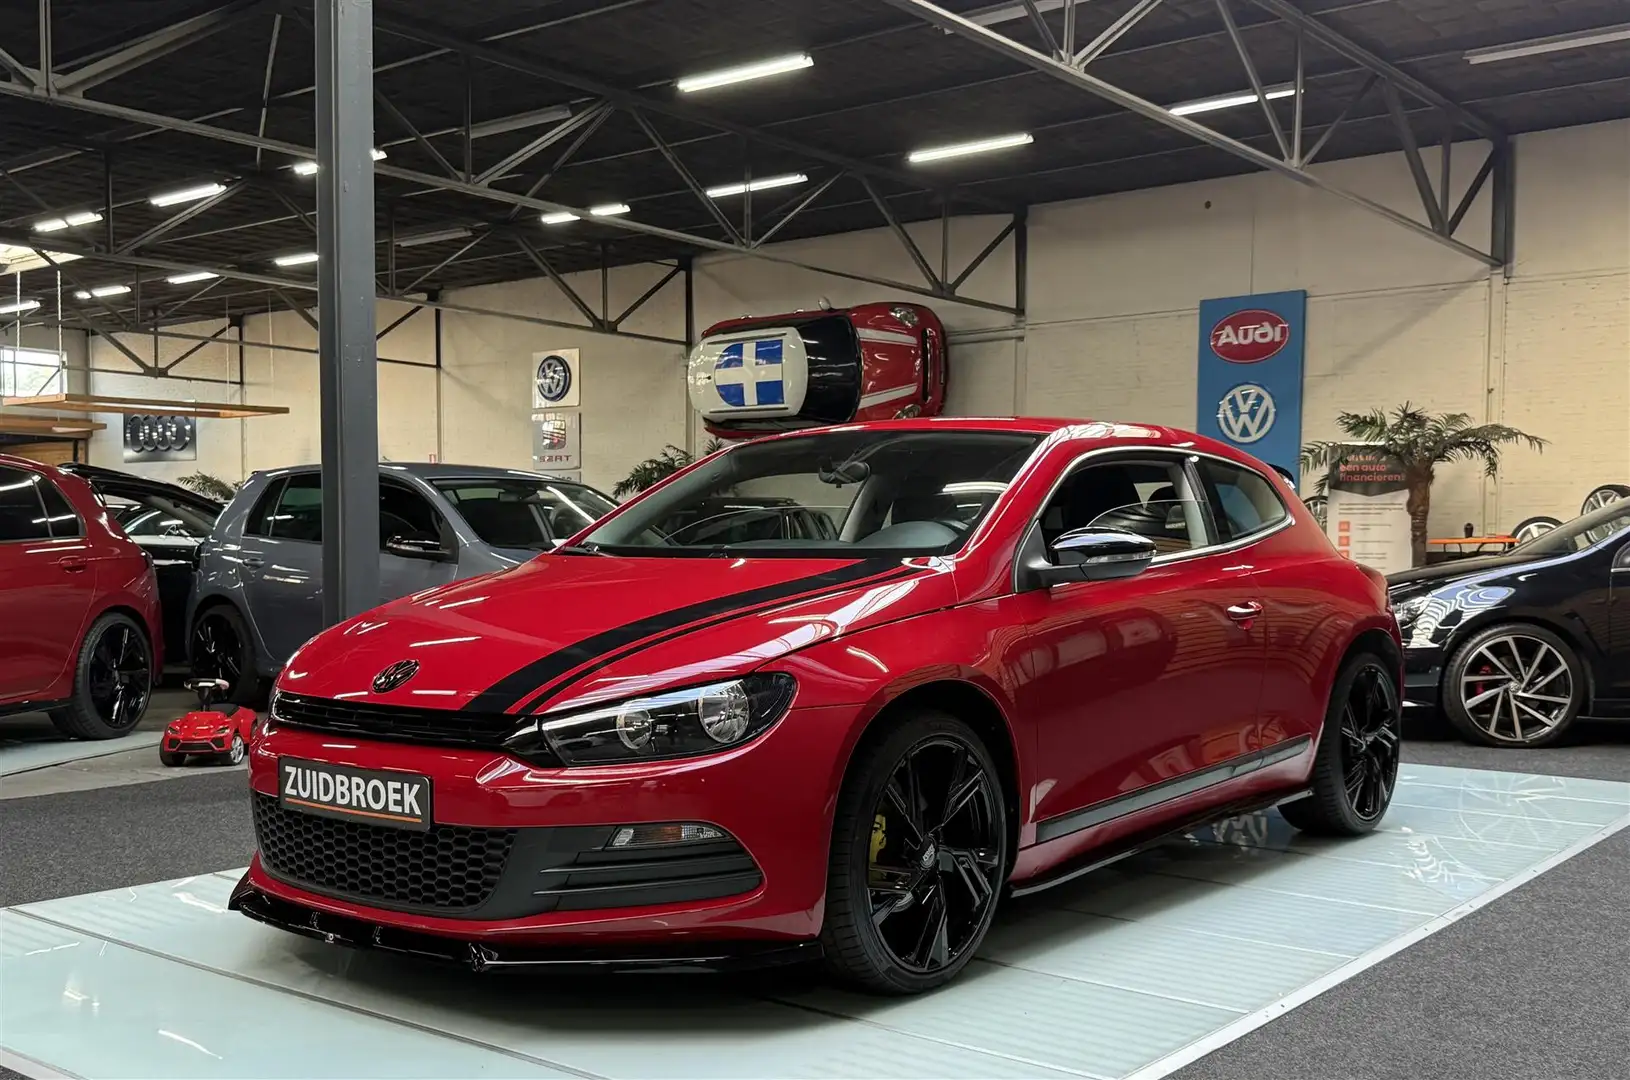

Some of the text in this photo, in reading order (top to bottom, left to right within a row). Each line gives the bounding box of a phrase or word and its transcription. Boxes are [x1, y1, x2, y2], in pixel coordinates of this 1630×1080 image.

[1216, 321, 1284, 347] Audi
[539, 454, 572, 463] SEAT
[1361, 463, 1387, 472] auto
[285, 765, 422, 816] ZUIDBROEK
